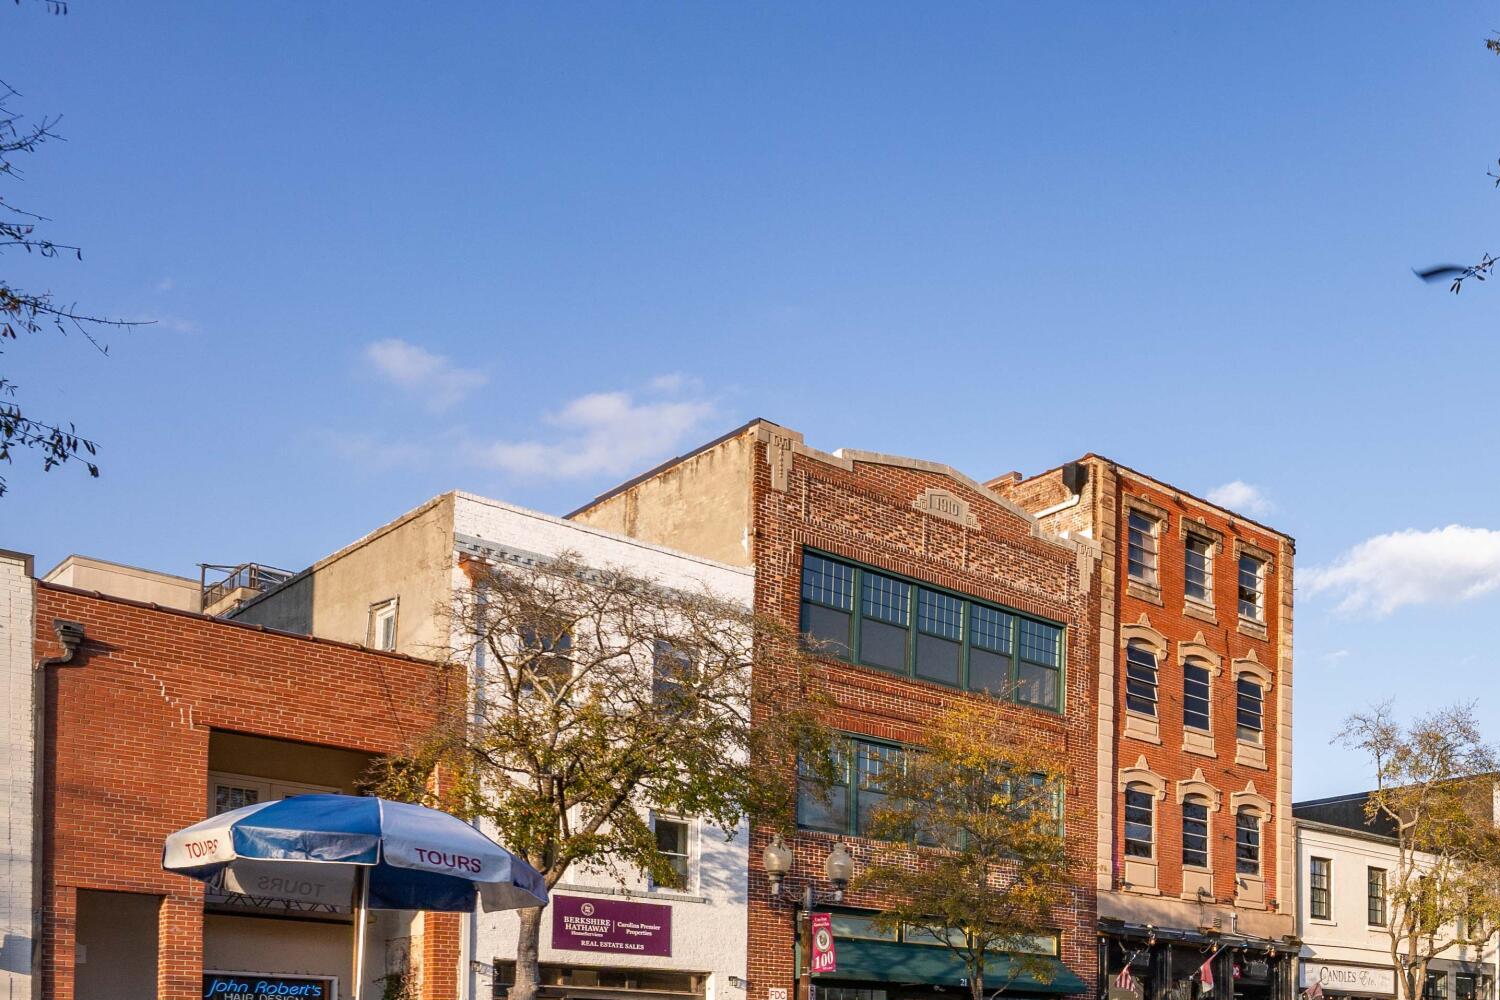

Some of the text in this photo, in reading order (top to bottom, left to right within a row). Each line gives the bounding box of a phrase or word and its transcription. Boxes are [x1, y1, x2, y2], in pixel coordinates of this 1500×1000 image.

[935, 496, 959, 516] 1910
[184, 838, 219, 860] TOURS
[415, 847, 482, 874] TOURS
[564, 916, 611, 926] BERKSHIRE
[617, 921, 661, 931] Carolina Premier
[565, 923, 609, 933] HATHAWAY
[625, 928, 653, 936] Properties
[599, 940, 624, 949] ESTATE
[815, 950, 834, 969] 100
[1320, 966, 1358, 986] CANDLES
[960, 978, 968, 987] 21
[204, 979, 323, 998] John Robert's
[770, 990, 786, 1000] FDC
